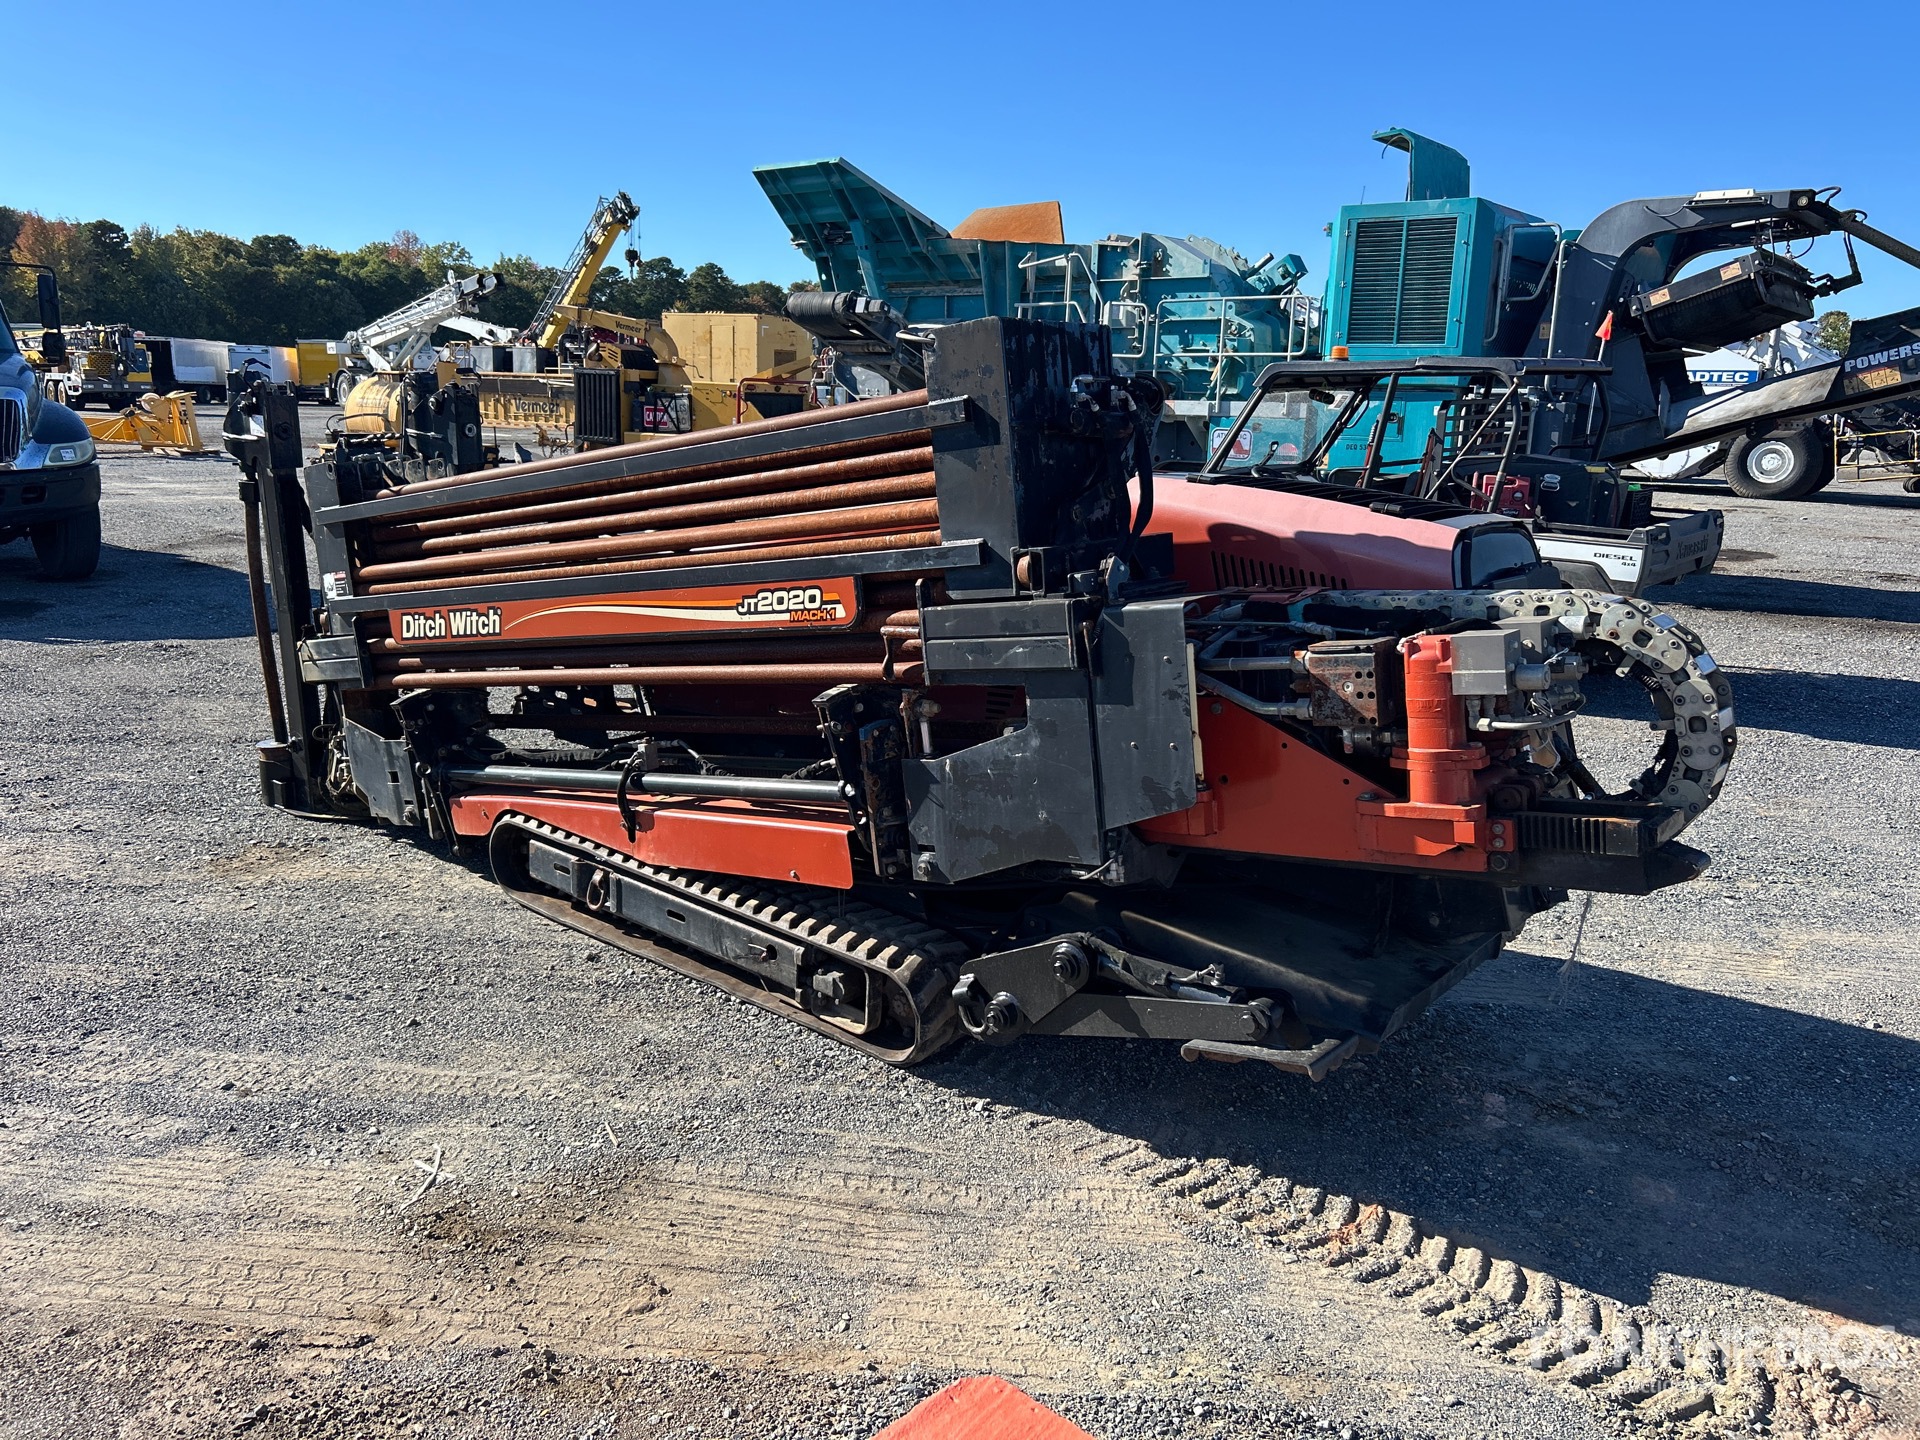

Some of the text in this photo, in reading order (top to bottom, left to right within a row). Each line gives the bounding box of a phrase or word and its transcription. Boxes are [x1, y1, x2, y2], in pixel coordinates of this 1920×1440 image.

[615, 320, 642, 334] Vermeer
[514, 396, 560, 414] Vermeer
[1593, 552, 1638, 562] DIESEL
[737, 587, 821, 614] JT2020
[401, 607, 500, 639] Ditch Witch
[789, 609, 836, 622] MACH 1
